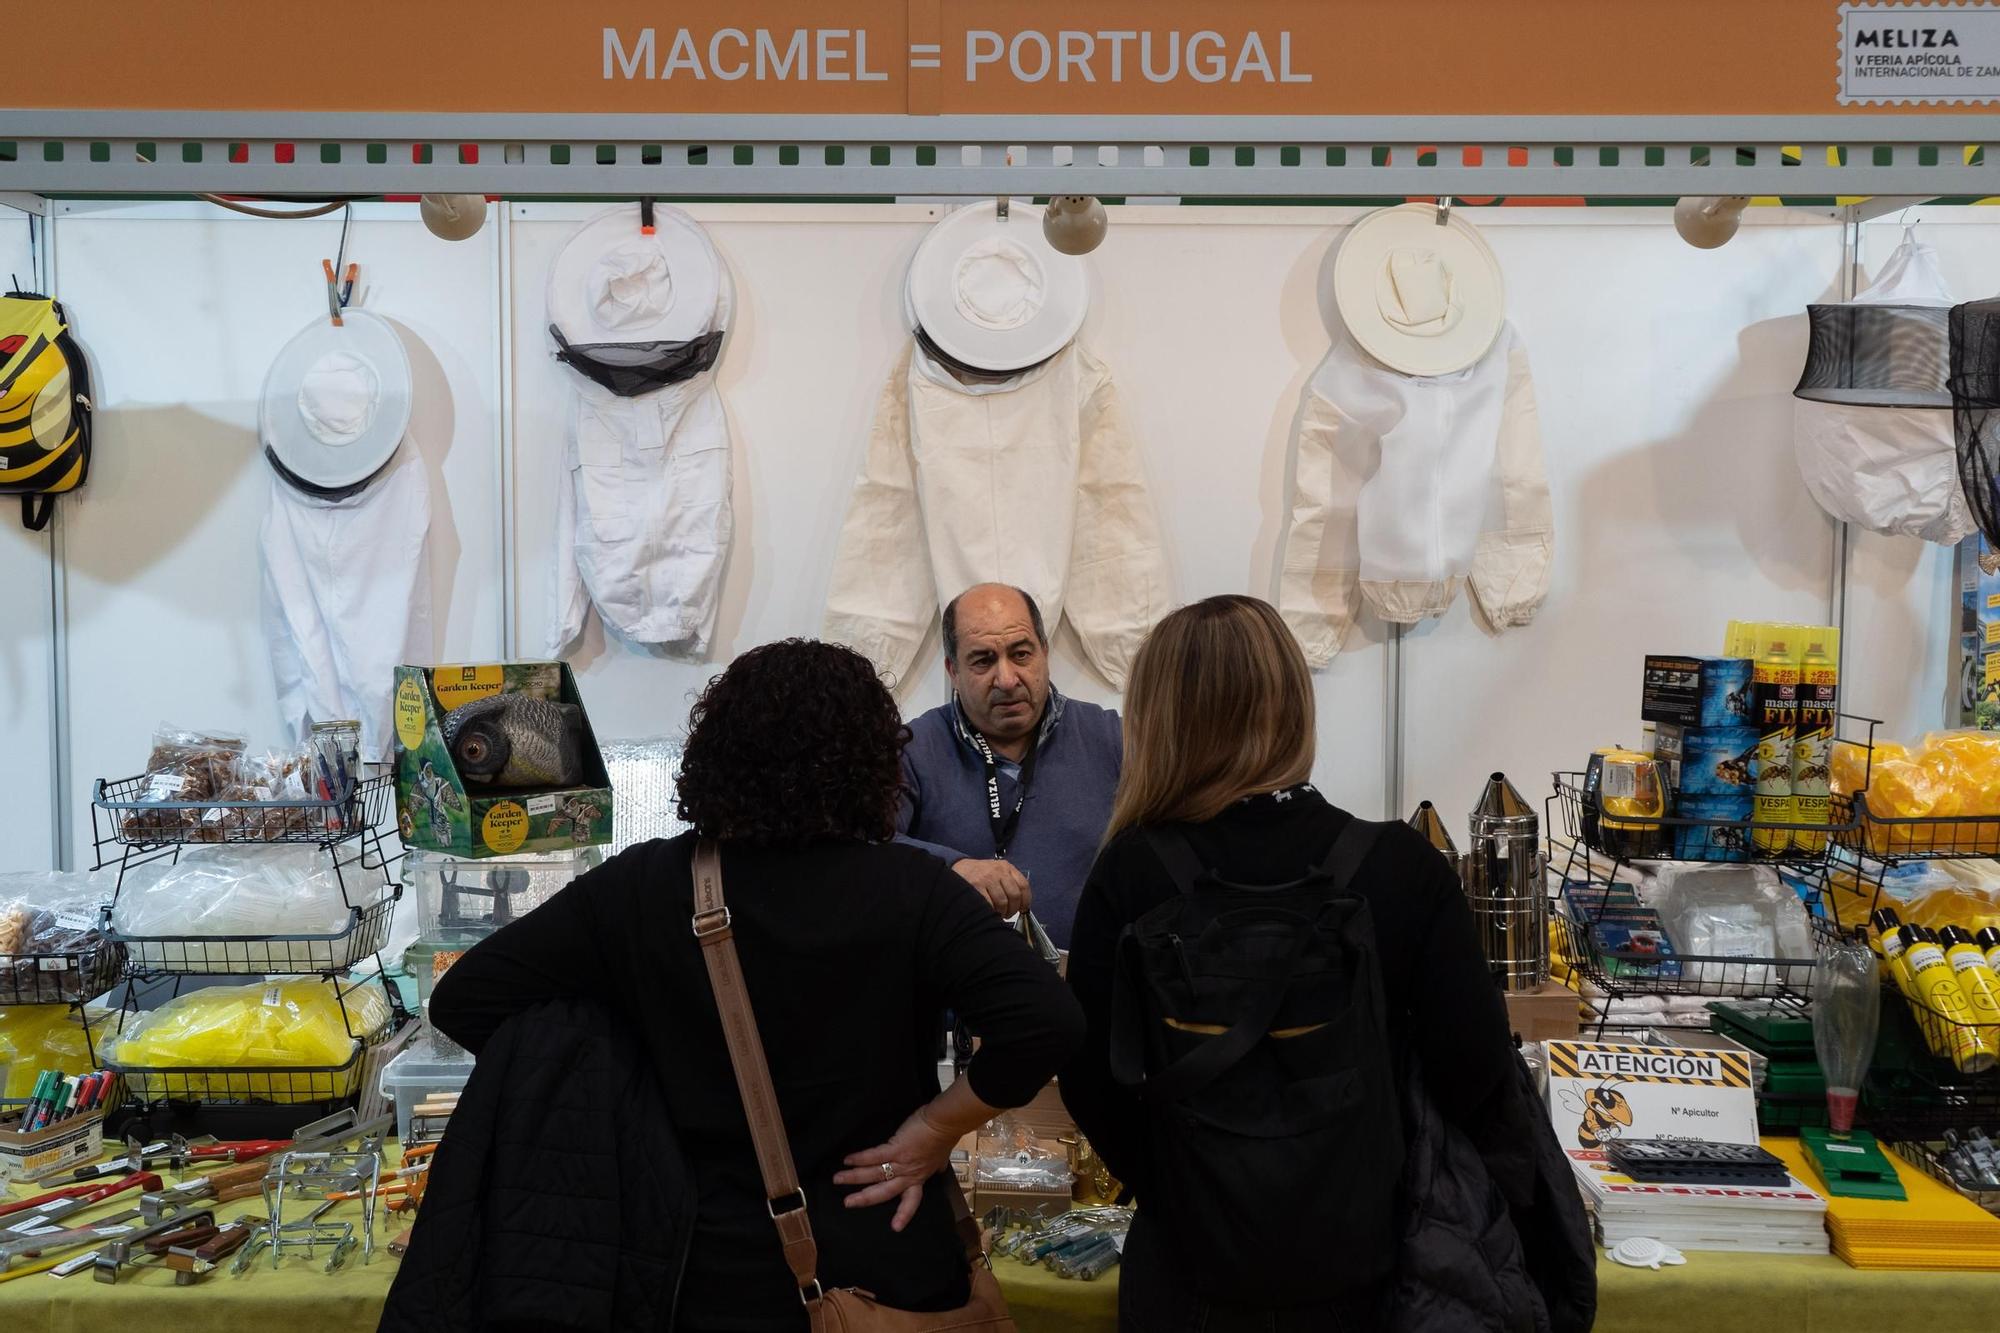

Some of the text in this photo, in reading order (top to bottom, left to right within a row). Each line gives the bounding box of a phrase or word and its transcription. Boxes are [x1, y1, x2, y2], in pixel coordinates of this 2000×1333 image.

[1855, 29, 1959, 48] MELIZA
[603, 28, 1313, 83] MACMEL = PORTUGAL
[1855, 52, 1961, 66] V FERIA APÍCOLA
[1855, 66, 1954, 77] INTERNACIONAL
[1957, 66, 1974, 77] DE
[437, 680, 501, 693] Garden Keeper
[399, 690, 421, 702] Garden
[400, 701, 421, 715] Keeper
[975, 732, 994, 765] MELIZA
[988, 777, 1000, 818] MELIZA
[489, 809, 522, 819] Garden
[490, 818, 523, 829] Keeper
[1583, 1052, 1714, 1077] ATENCIÓN
[1683, 1107, 1720, 1118] Apicultor
[1667, 1134, 1704, 1143] Contacto
